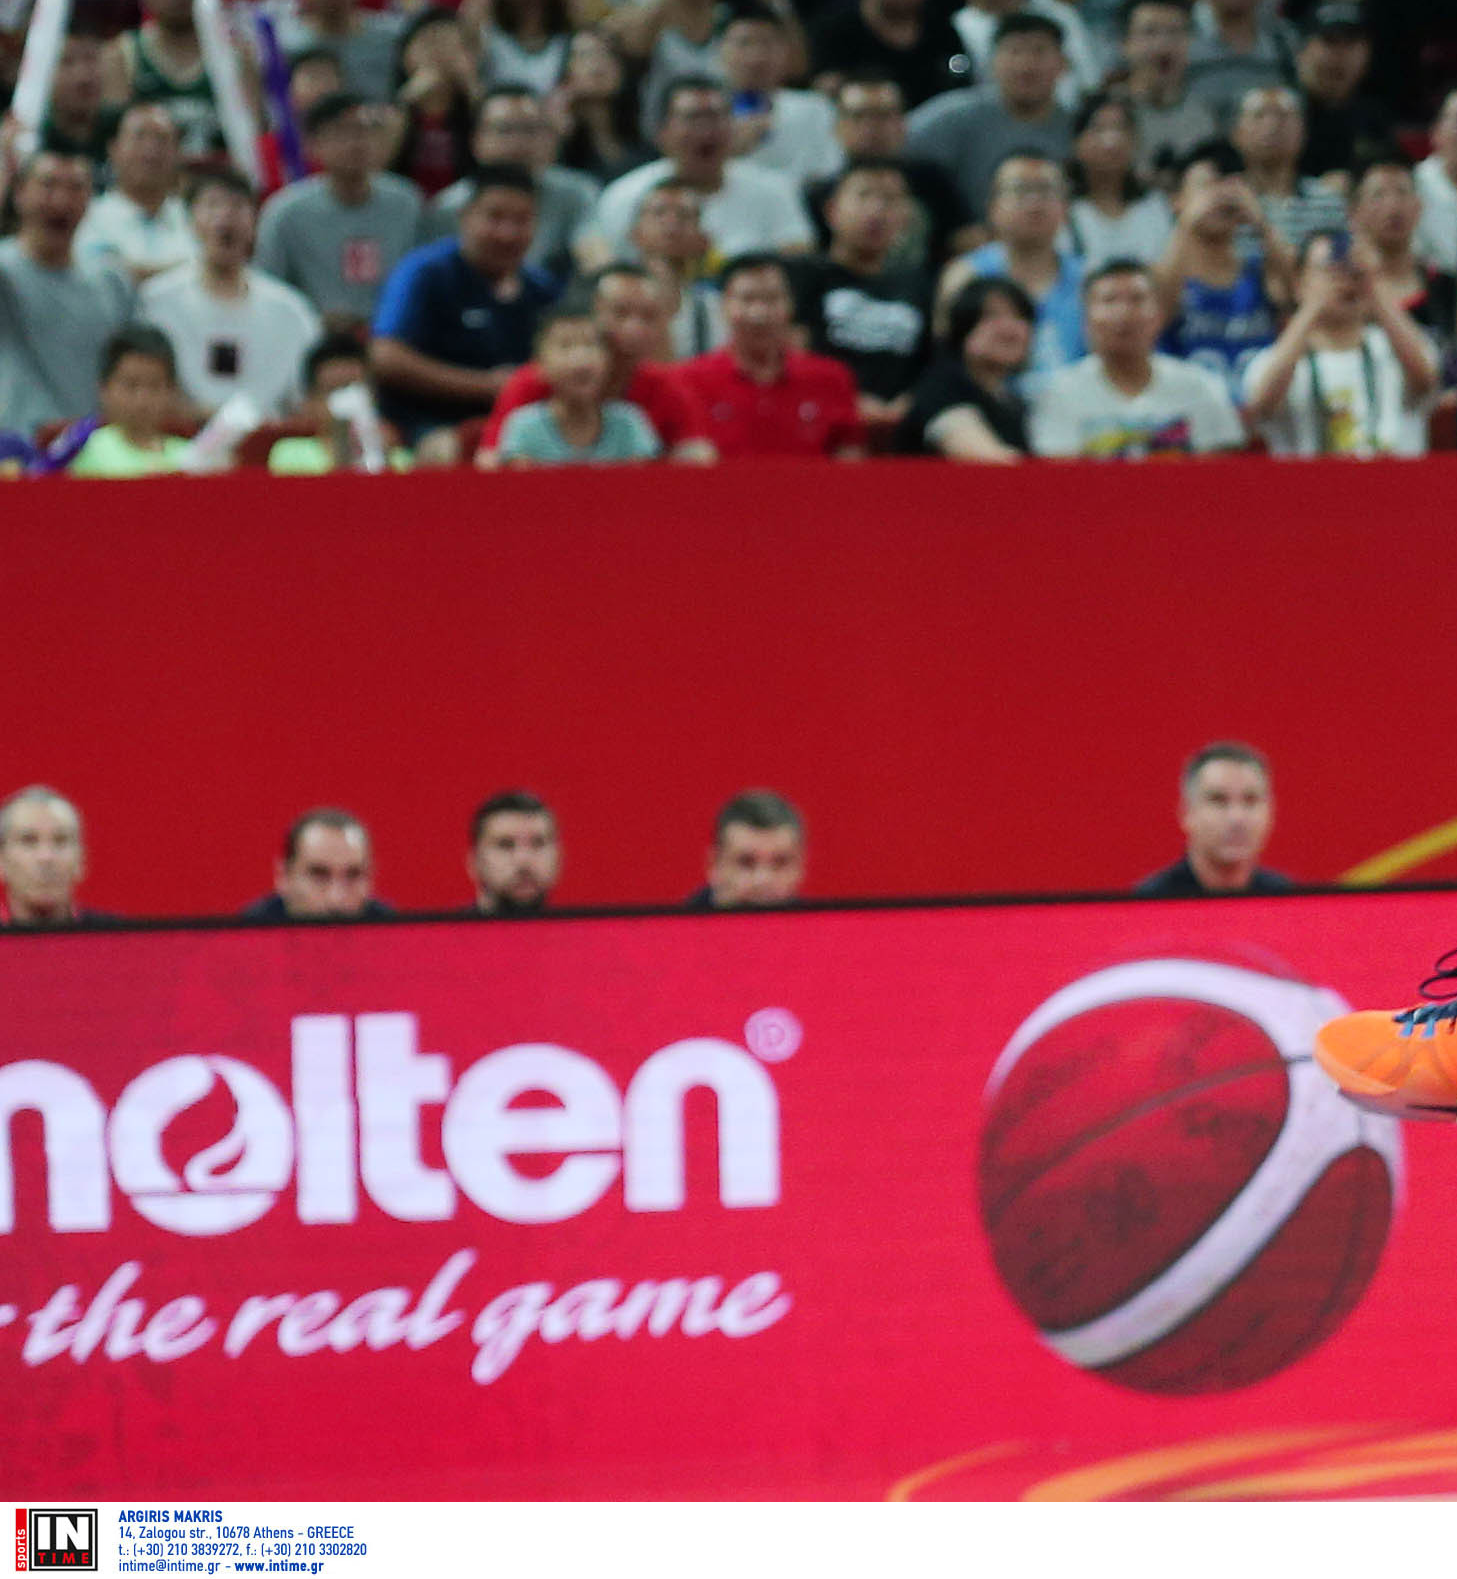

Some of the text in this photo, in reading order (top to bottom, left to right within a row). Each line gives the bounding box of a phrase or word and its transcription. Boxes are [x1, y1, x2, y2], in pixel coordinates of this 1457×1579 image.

[21, 1248, 794, 1386] the real game
